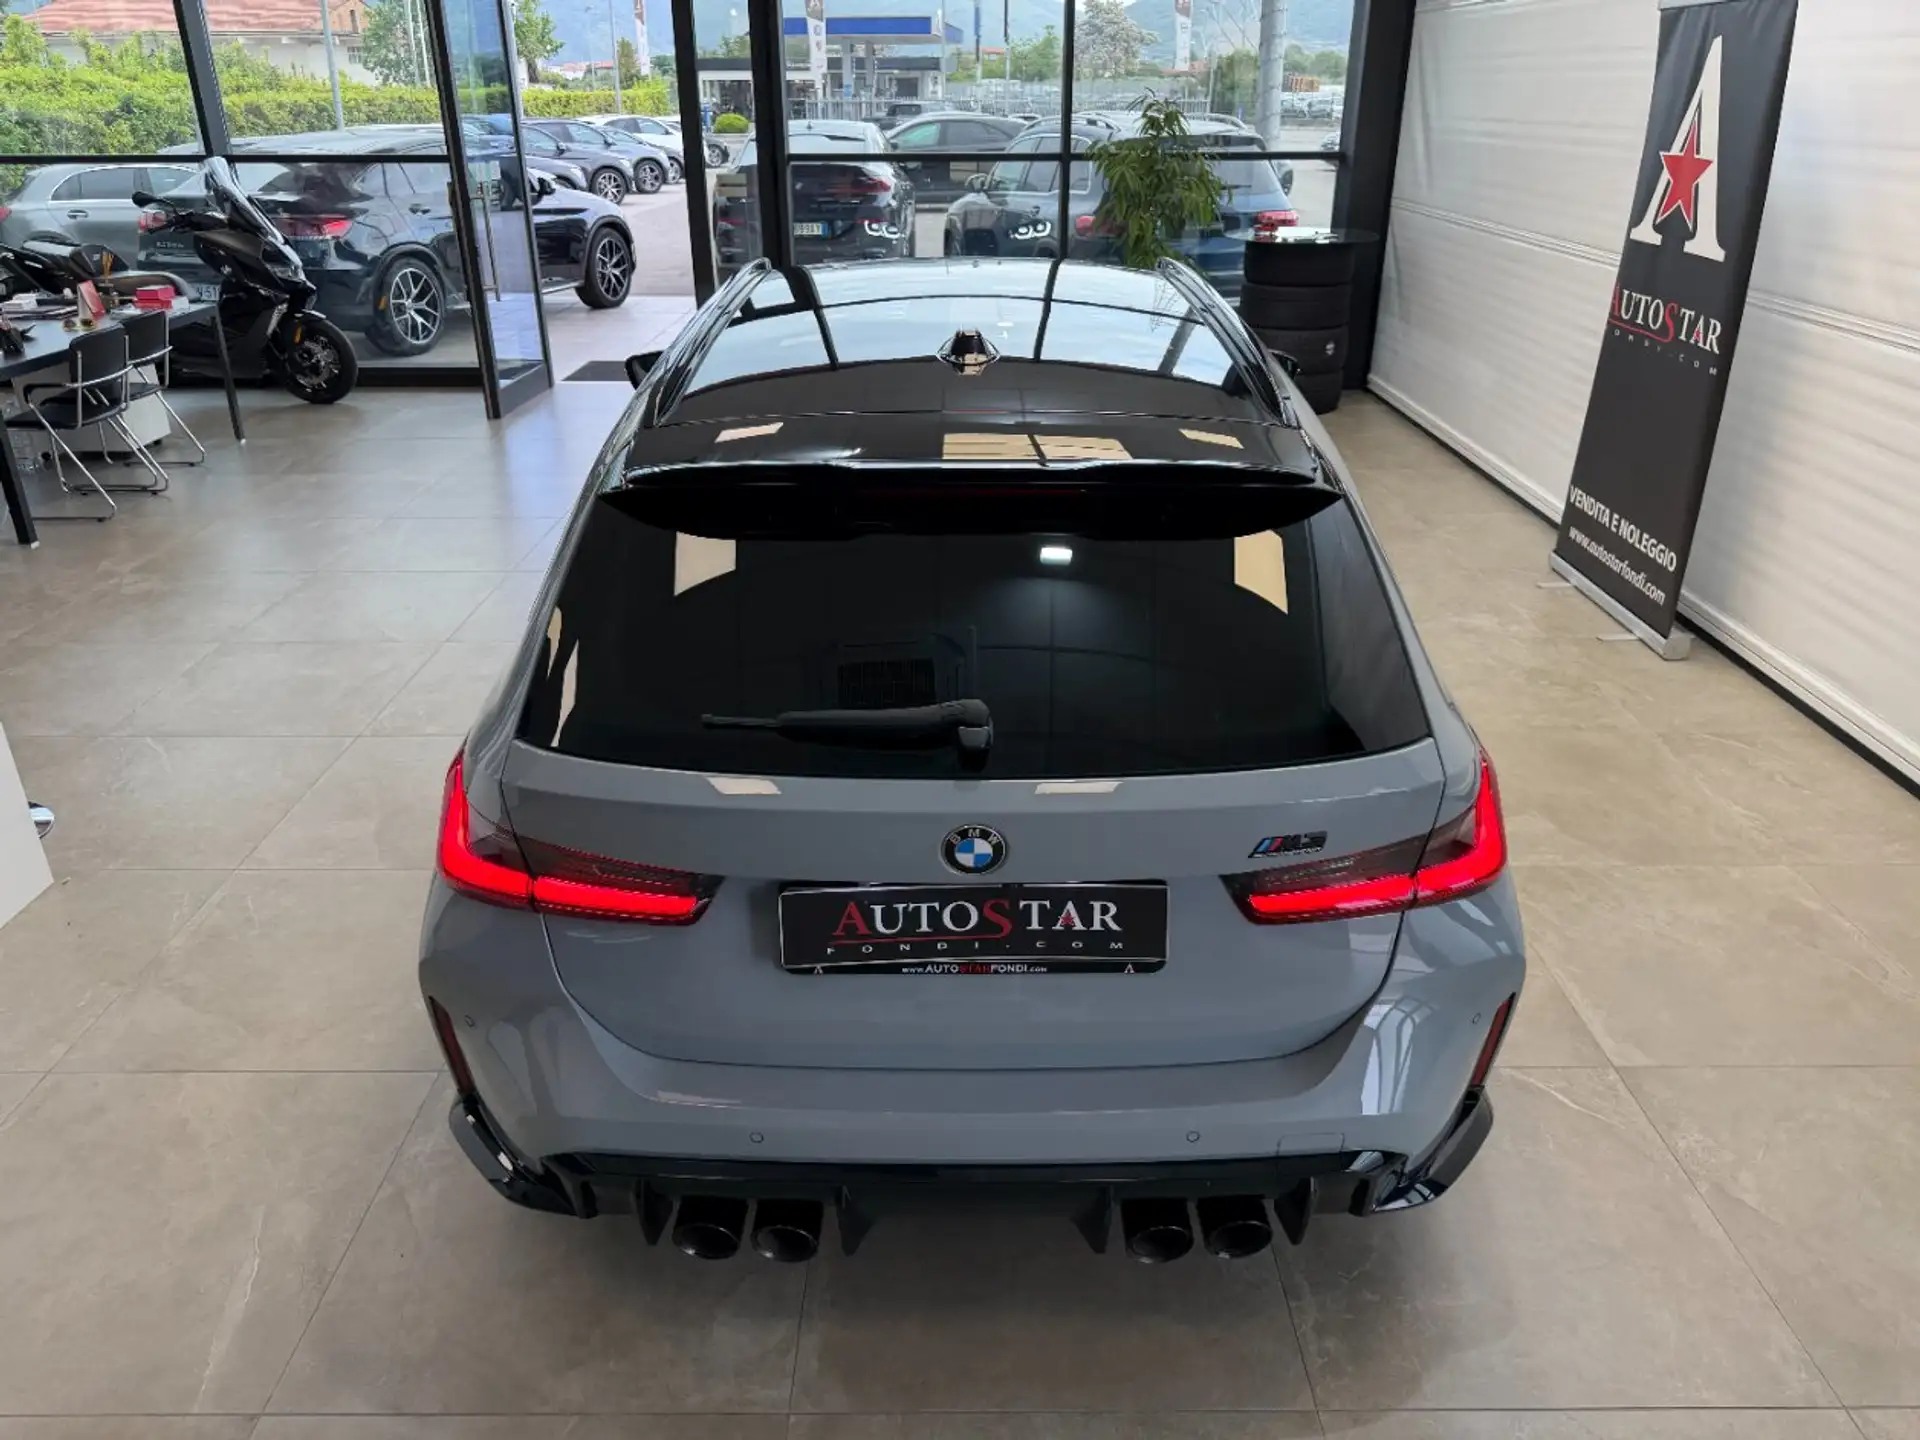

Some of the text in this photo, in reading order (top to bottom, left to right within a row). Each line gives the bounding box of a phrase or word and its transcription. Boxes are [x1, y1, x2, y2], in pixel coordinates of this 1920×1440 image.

[1568, 526, 1666, 606] www.autostarfondi.com
[1569, 484, 1677, 572] VENDITA E NOLEGGIO
[832, 899, 1123, 939] AUTOSTAR
